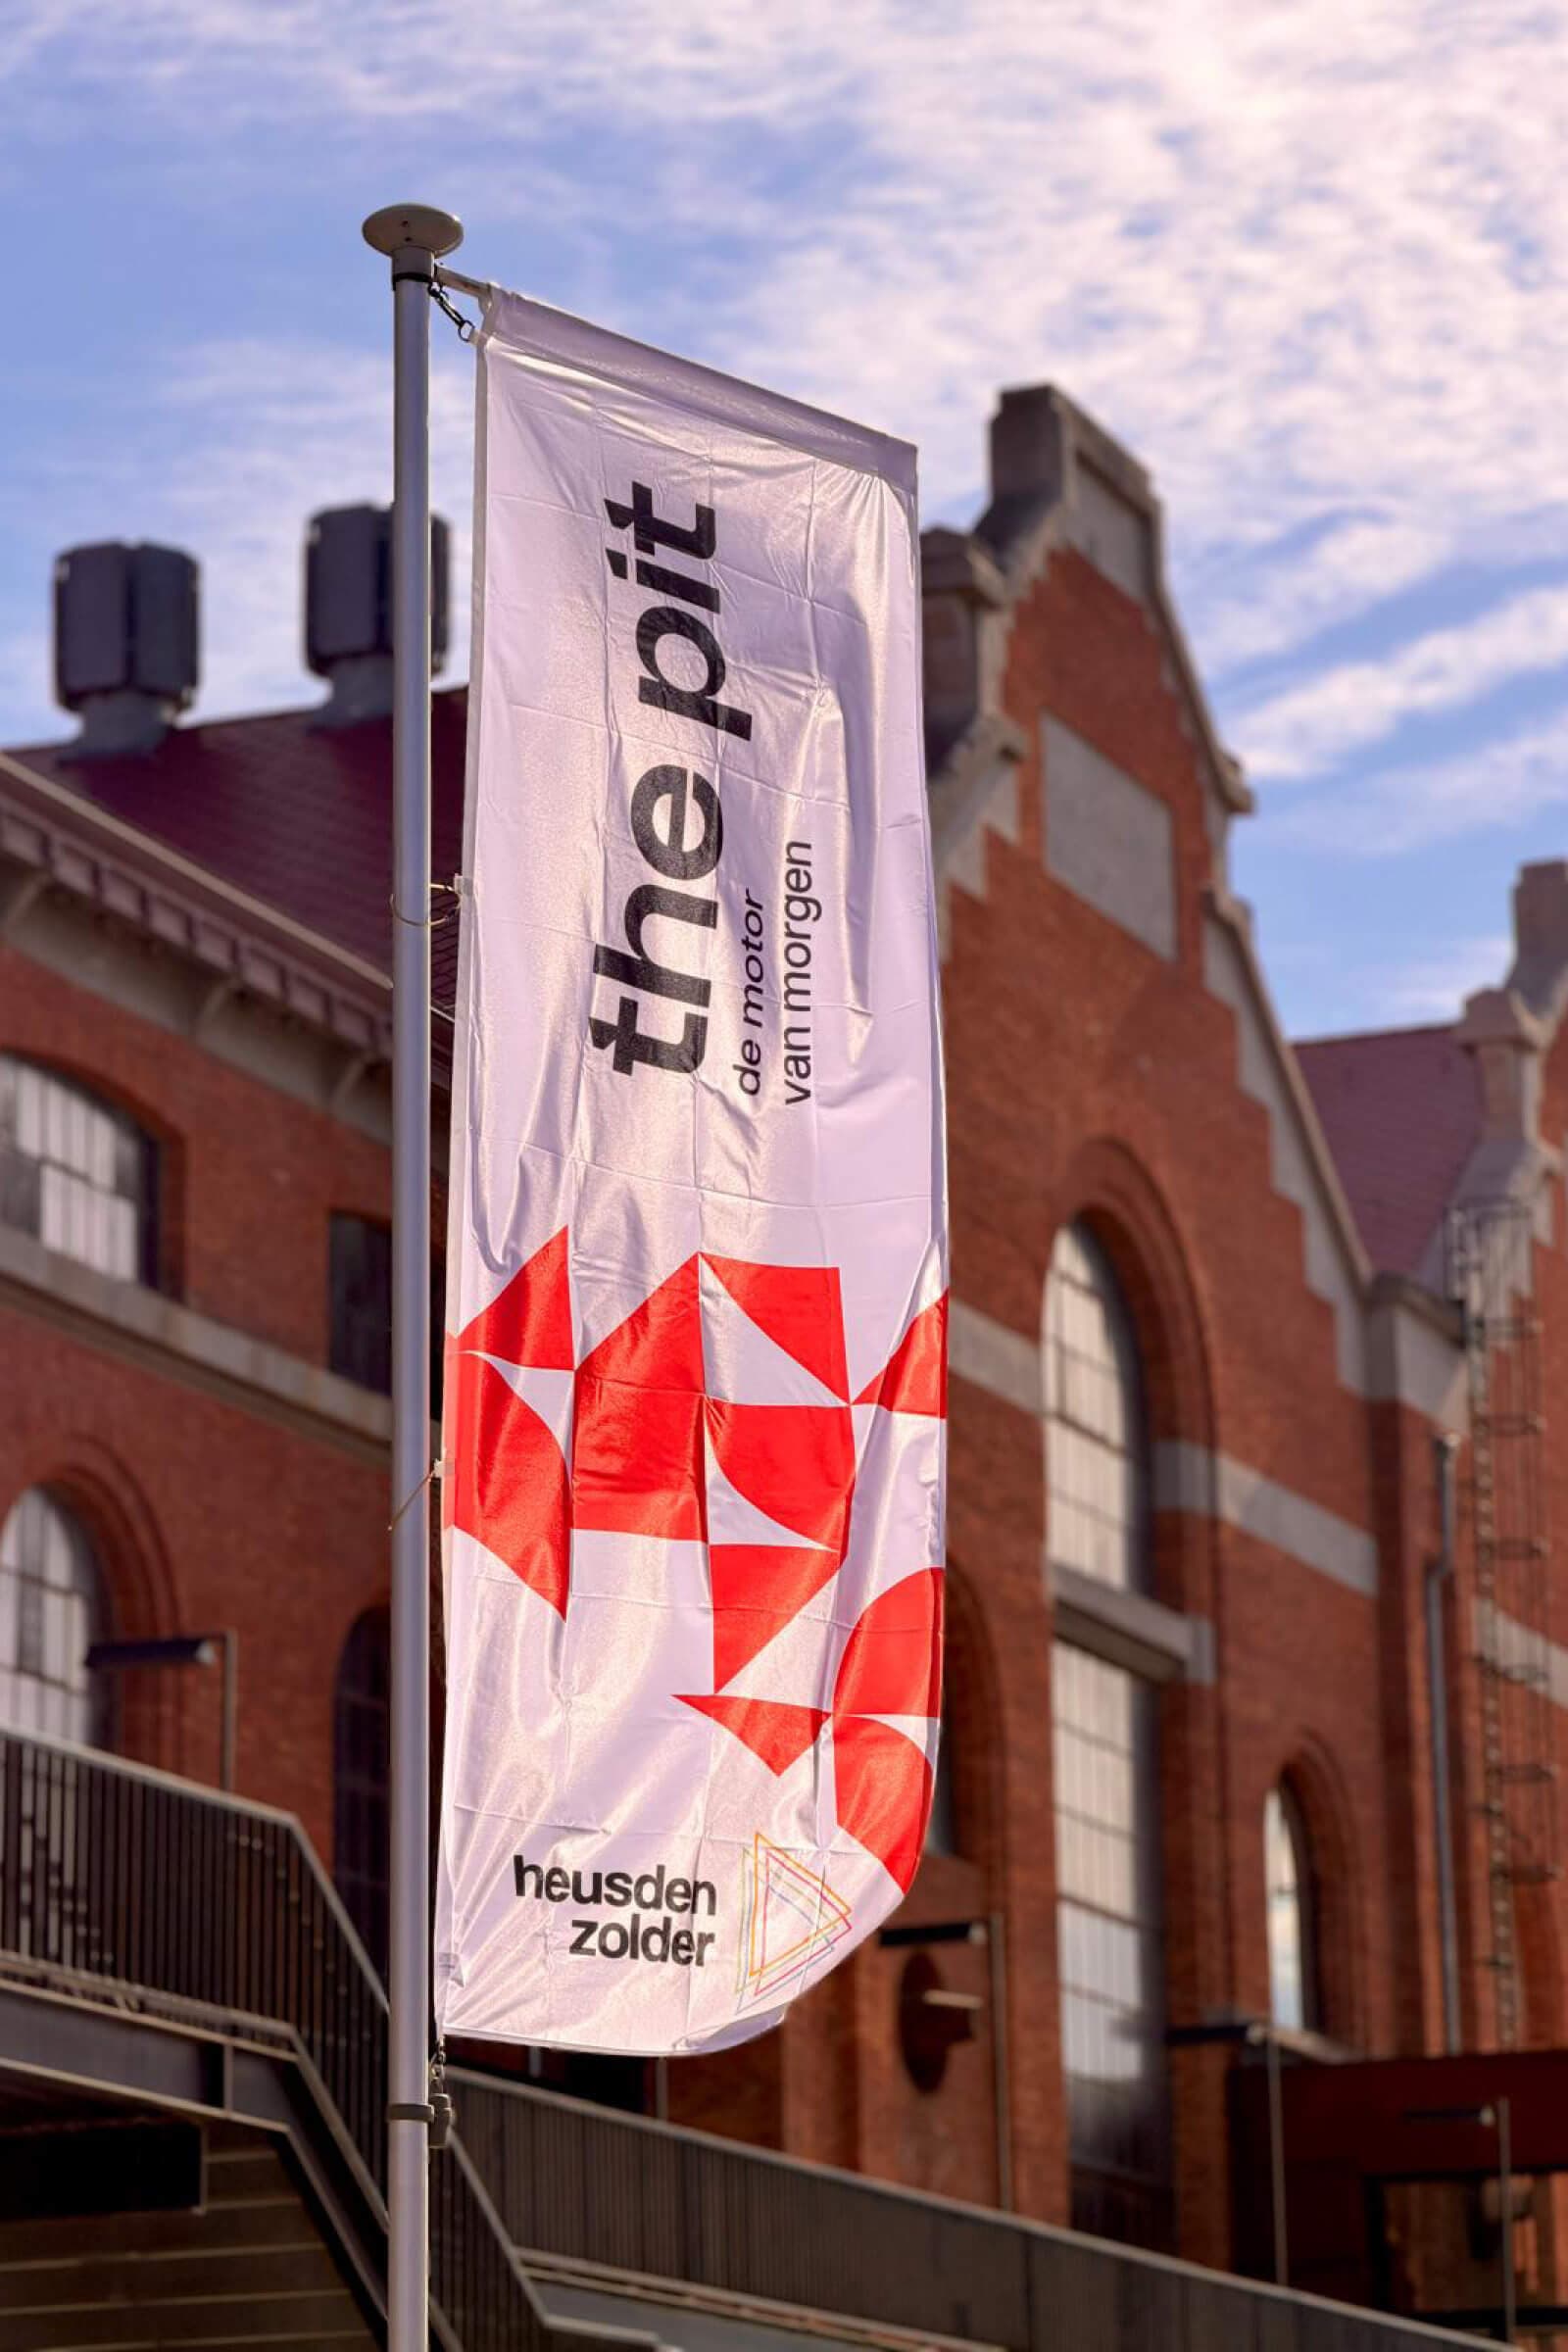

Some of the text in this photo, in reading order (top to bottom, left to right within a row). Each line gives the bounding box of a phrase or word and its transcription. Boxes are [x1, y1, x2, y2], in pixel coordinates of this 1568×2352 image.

[587, 480, 753, 1076] the pit
[733, 886, 765, 1096] de motor
[783, 841, 822, 1104] van morgen
[514, 1854, 717, 1915] heusden
[568, 1913, 716, 1967] zolder
